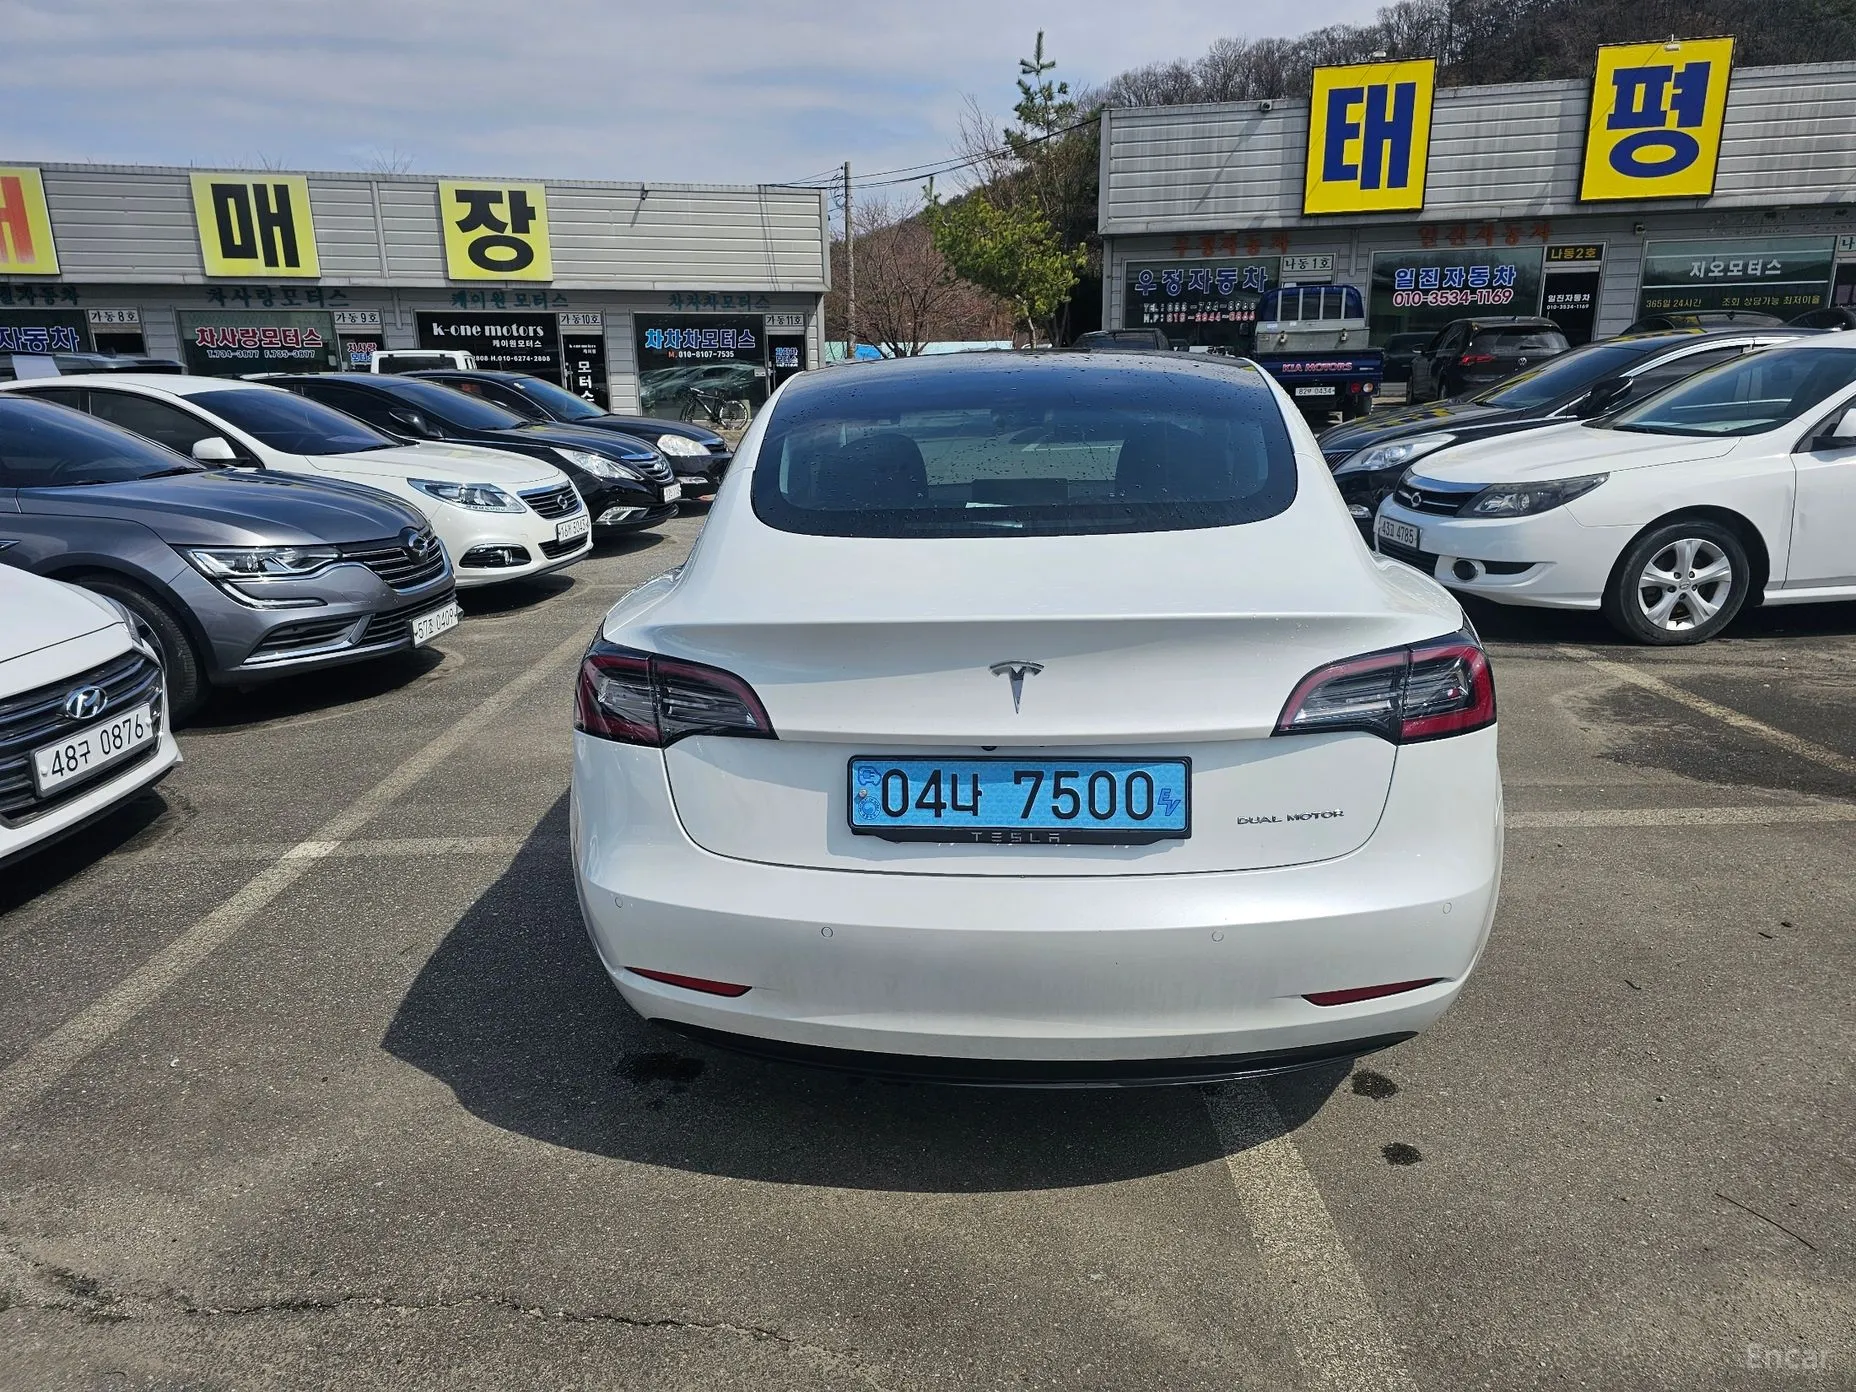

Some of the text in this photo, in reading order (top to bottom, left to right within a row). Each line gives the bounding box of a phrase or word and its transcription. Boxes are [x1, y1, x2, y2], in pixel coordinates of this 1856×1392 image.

[1607, 61, 1710, 177] 평
[1323, 82, 1416, 190] 태
[210, 183, 300, 268] 매
[455, 189, 536, 272] 장
[1394, 264, 1517, 290] 일진자동차
[1689, 259, 1782, 278] 지오모터스
[1134, 265, 1269, 297] 우정자동차
[206, 286, 349, 308] 차사랑모터스
[1393, 289, 1514, 307] 010-3534-1169
[195, 327, 323, 349] 차사랑모터스
[432, 323, 544, 337] k-one motors
[645, 328, 756, 349] 차차차모터스
[493, 339, 542, 348] 케이원모터스
[1282, 362, 1353, 372] KIA MOTORS
[1396, 525, 1414, 543] 4785
[436, 608, 453, 630] 0409
[51, 713, 144, 776] 48구 0876
[881, 768, 983, 818] 04나
[1013, 770, 1154, 820] 7500
[1236, 809, 1345, 825] DUAL MOTOR
[971, 831, 1061, 843] TESLA
